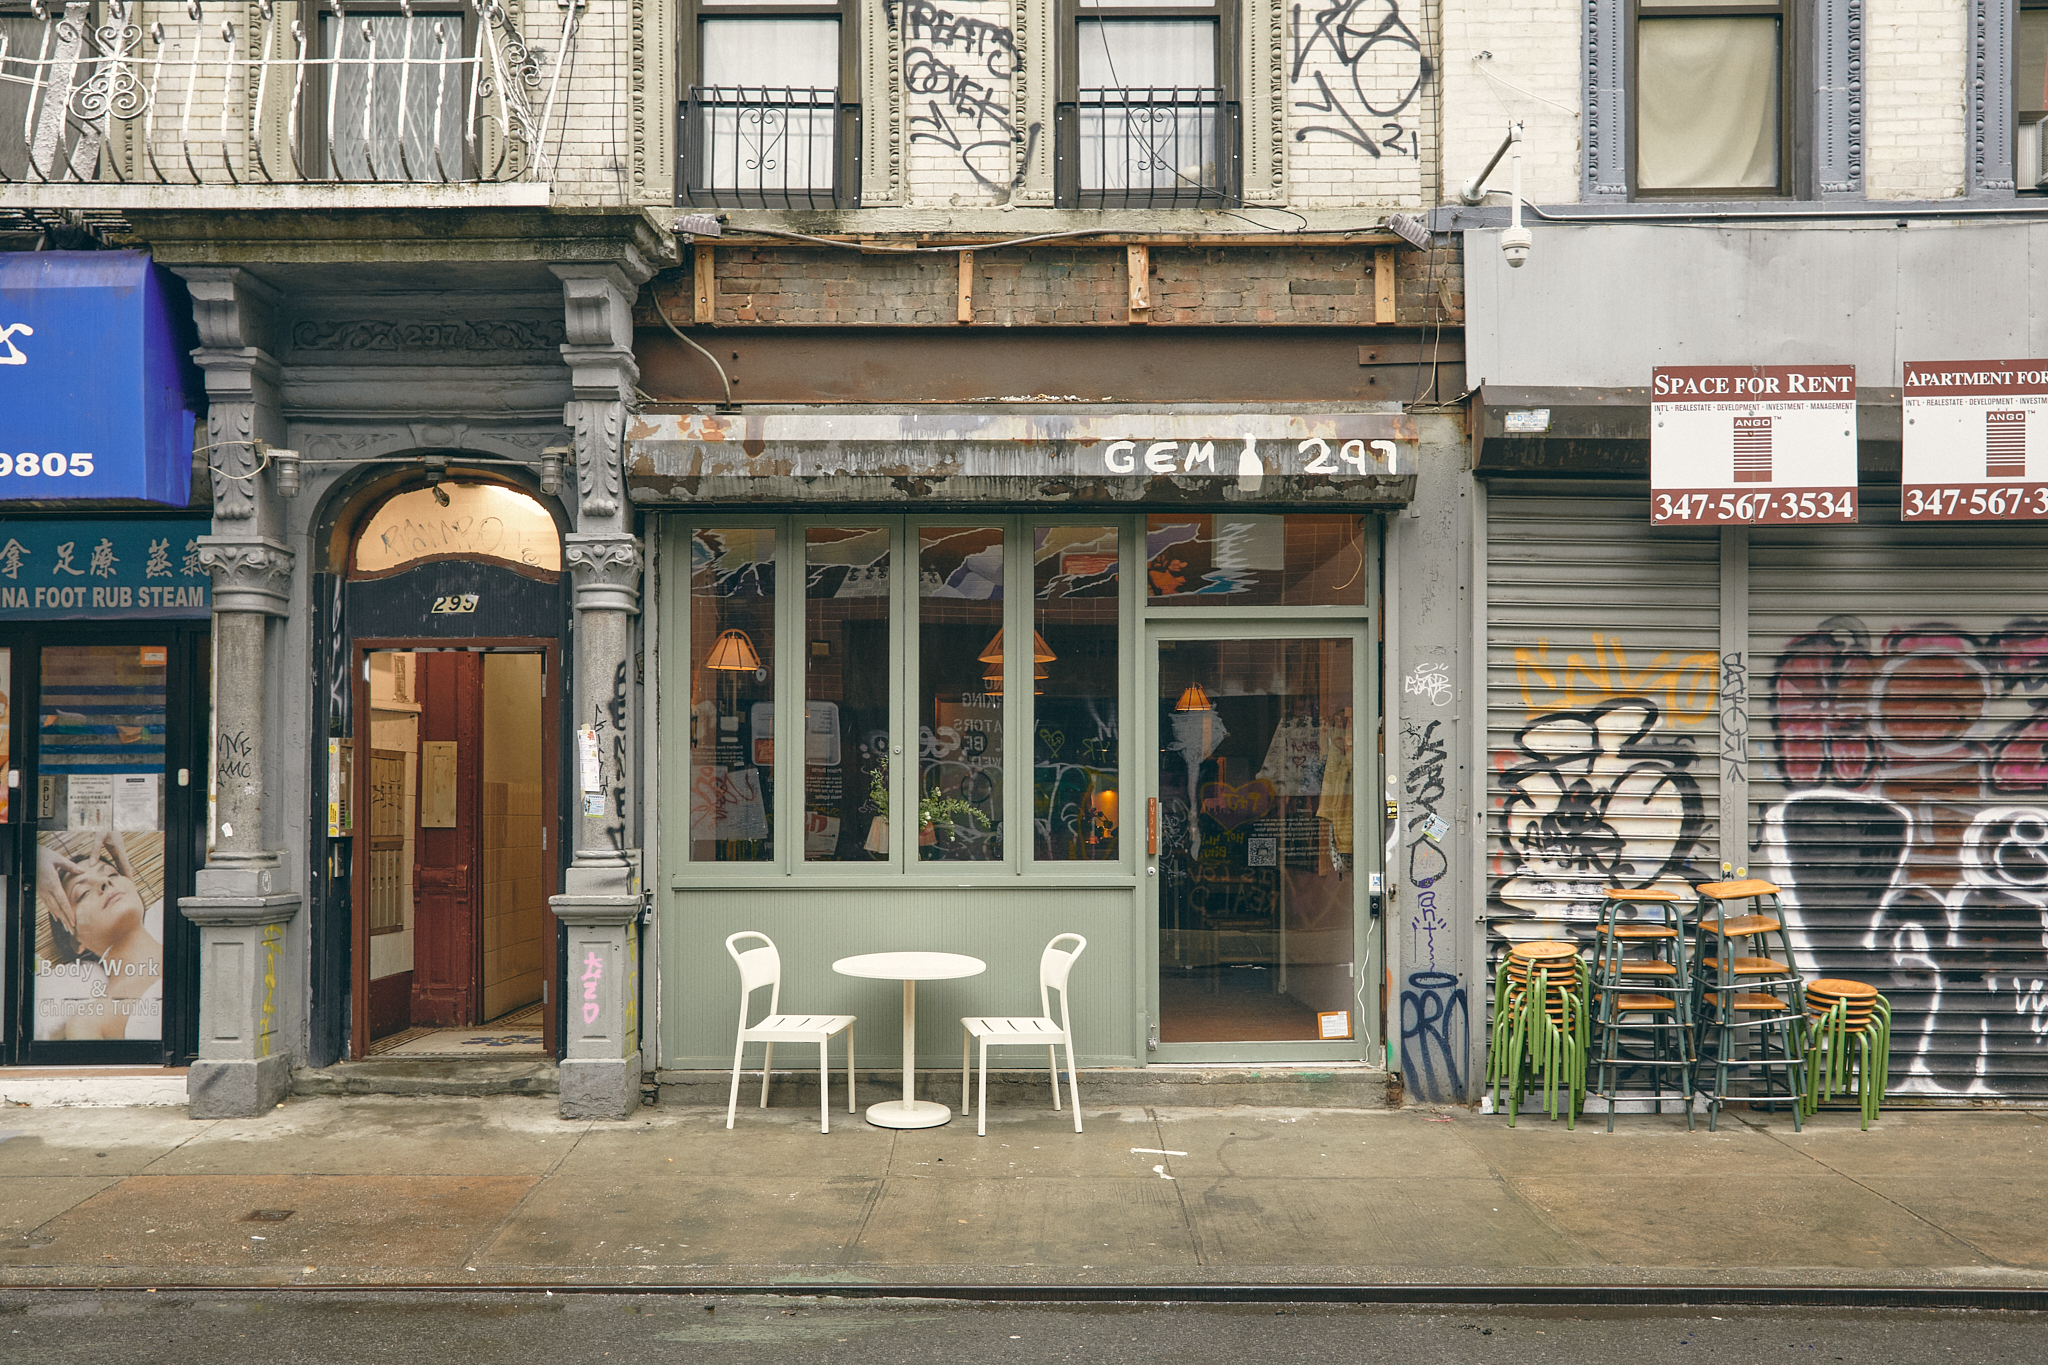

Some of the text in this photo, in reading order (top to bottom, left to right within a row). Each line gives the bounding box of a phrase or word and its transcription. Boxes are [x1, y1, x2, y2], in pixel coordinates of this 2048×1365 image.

[1654, 374, 1852, 396] SPACE FOR RENT
[1905, 370, 2014, 387] APARTMENT
[1717, 403, 1760, 411] DEVELOPMENT
[1765, 402, 1804, 410] INVESTMENT
[1810, 402, 1853, 410] MANAGEMENT
[1969, 398, 2014, 406] DEVELOPMENT
[1735, 419, 1771, 427] ANGO
[1988, 413, 2025, 421] ANGO
[1104, 437, 1397, 476] GEM 297
[35, 587, 87, 608] FOOT
[92, 587, 132, 608] RUB
[138, 586, 204, 608] STEAM
[42, 786, 50, 816] PULL
[40, 958, 160, 982] Body Work
[91, 980, 108, 998] &
[39, 999, 159, 1017] Chinese TuiNa
